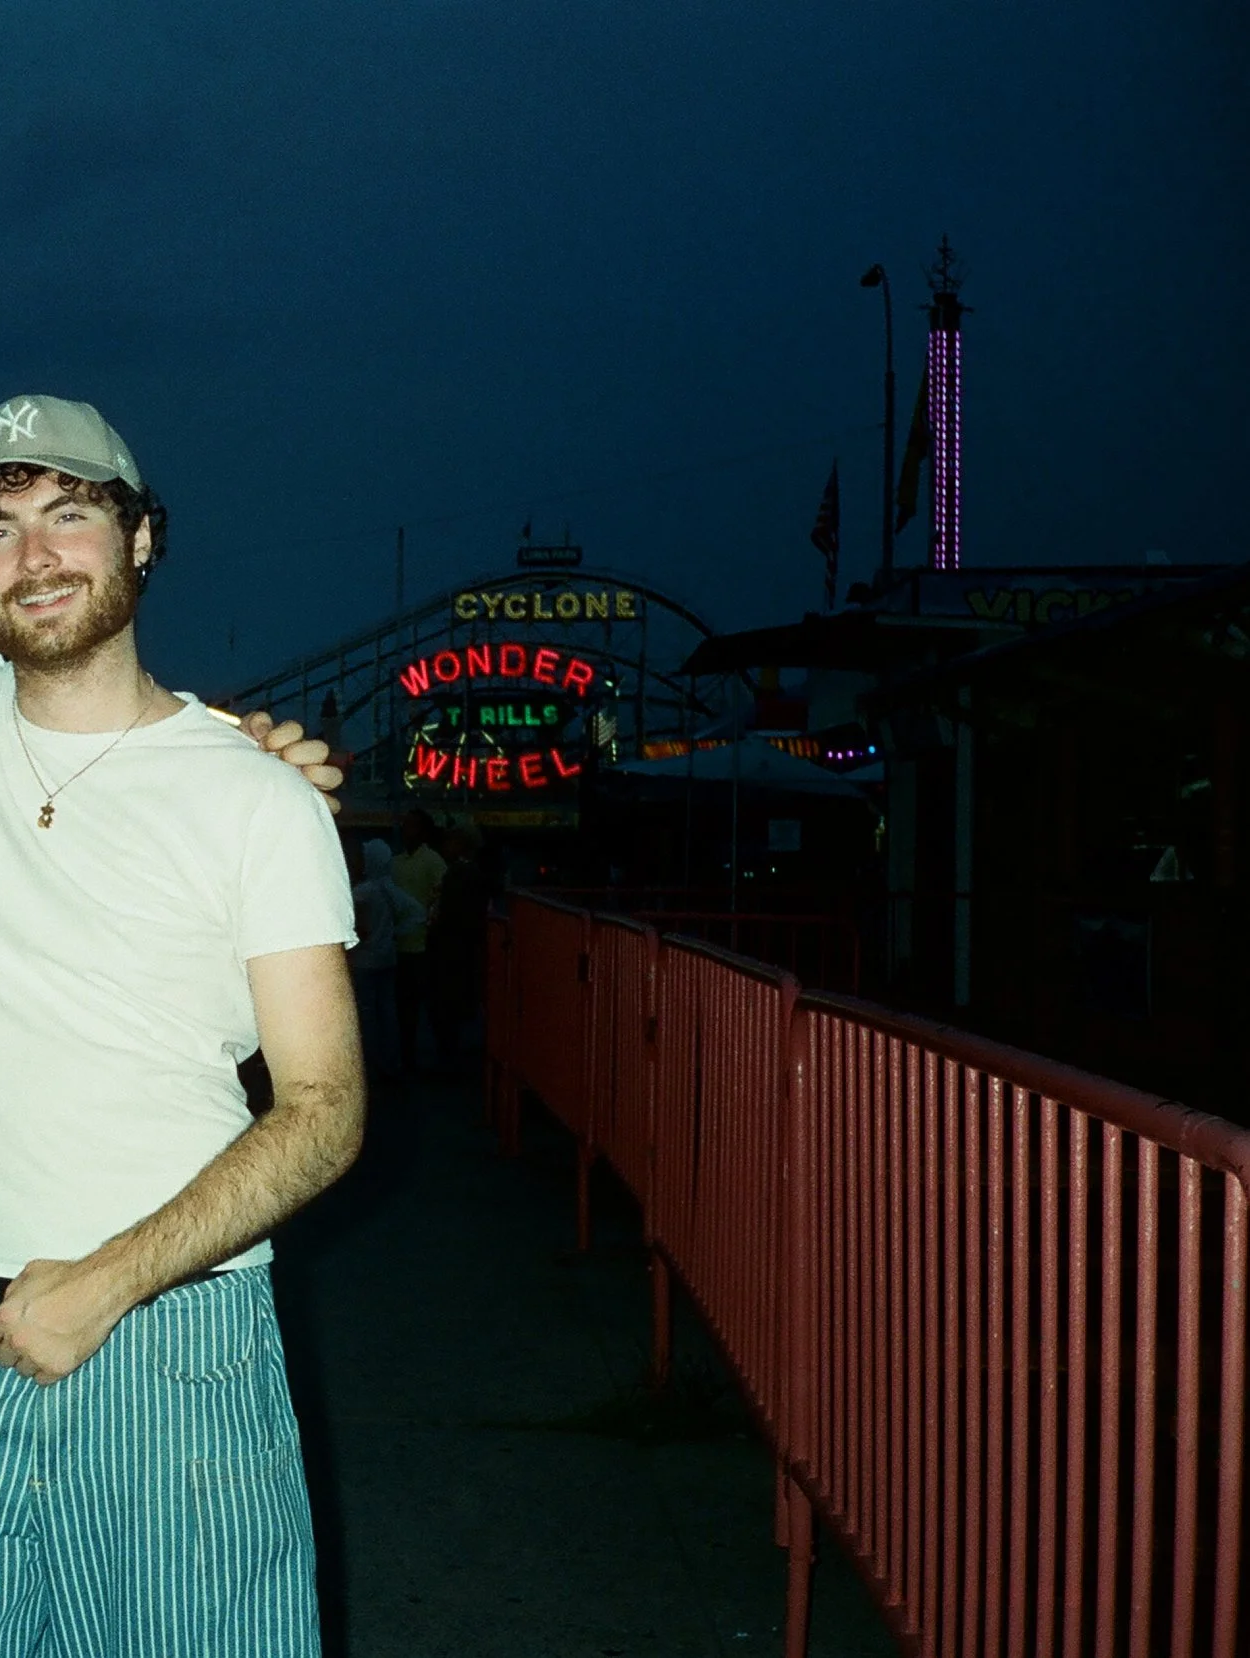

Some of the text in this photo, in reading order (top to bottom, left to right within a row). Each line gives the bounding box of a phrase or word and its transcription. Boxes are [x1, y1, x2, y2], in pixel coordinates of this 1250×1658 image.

[454, 591, 637, 620] CYCLONE
[399, 641, 595, 698] WONDER
[415, 744, 584, 792] WHEEL
